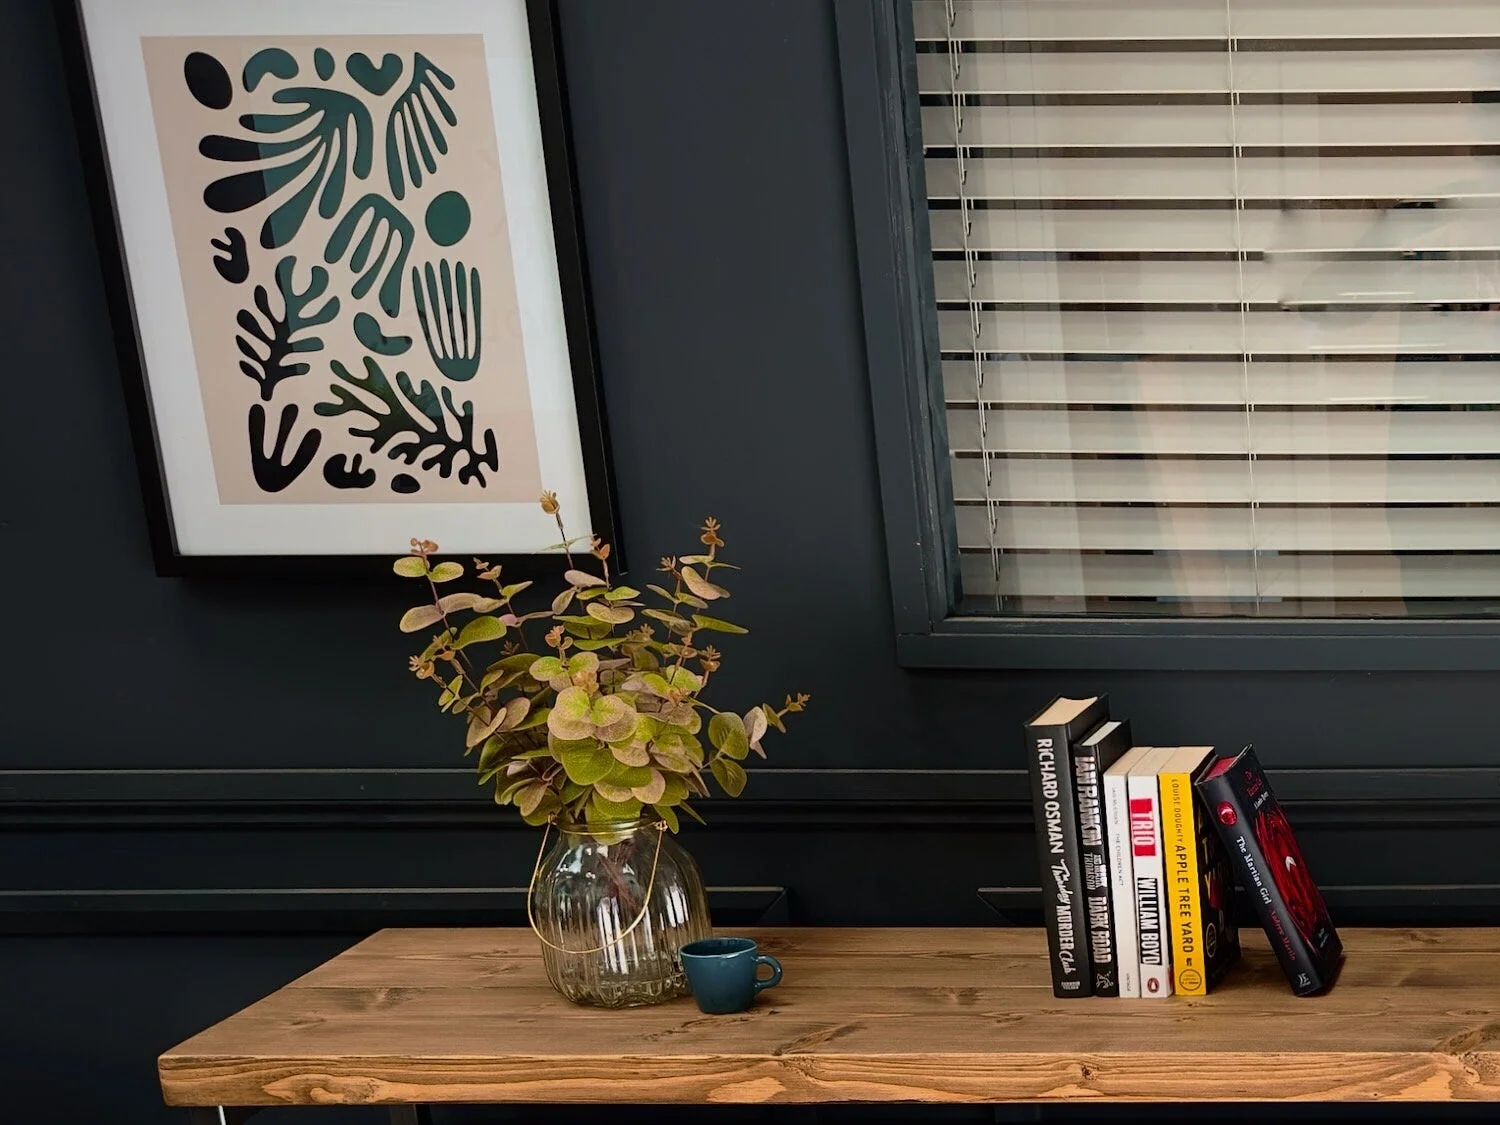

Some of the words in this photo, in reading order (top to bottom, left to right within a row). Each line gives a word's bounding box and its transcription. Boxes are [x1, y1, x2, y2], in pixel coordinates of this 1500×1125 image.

[1075, 756, 1097, 785] IAN
[1171, 779, 1181, 806] LOUISE
[1044, 800, 1065, 855] OSMAN
[1077, 785, 1102, 846] RANKIN
[1133, 811, 1155, 846] TRIO
[1173, 808, 1184, 842] DOUGHTY
[1175, 845, 1189, 884] APPLE
[1236, 836, 1247, 854] The
[1243, 853, 1263, 887] Martian
[1260, 886, 1272, 904] Girl
[1088, 896, 1109, 929] DARK
[1138, 878, 1158, 930] WILLIAM
[1178, 887, 1192, 918] TREE
[1056, 905, 1075, 950] MURDER
[1180, 921, 1194, 953] YARD
[1058, 950, 1077, 975] Club
[1091, 929, 1113, 964] ROAD
[1140, 932, 1161, 965] BOYD
